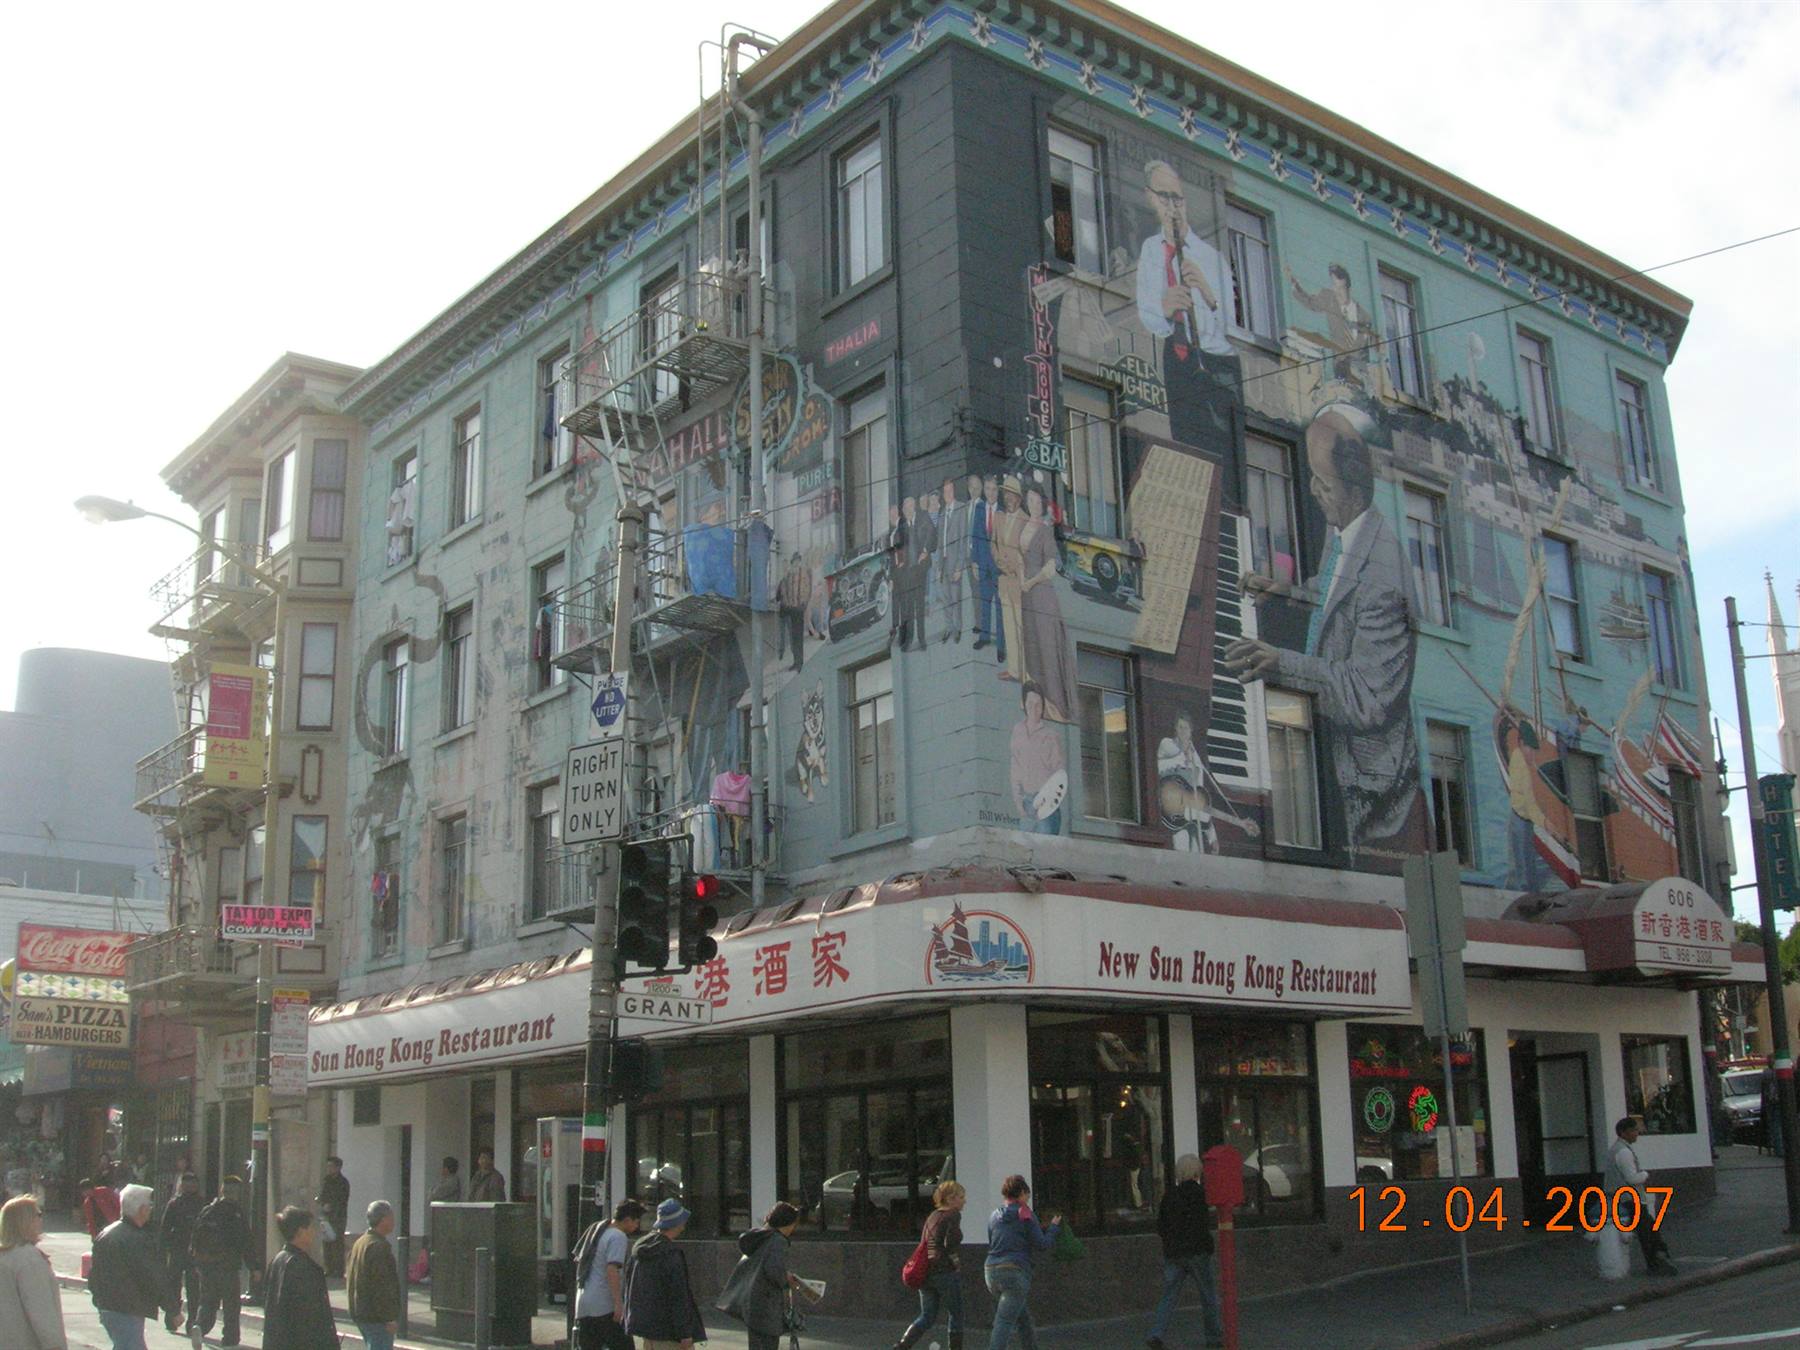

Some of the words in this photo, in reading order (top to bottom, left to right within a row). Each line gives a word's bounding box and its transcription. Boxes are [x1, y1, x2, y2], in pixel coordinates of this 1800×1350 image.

[825, 320, 879, 363] THALIA
[596, 703, 621, 718] LITTER
[572, 750, 619, 777] RIGHT
[571, 779, 618, 804] TURN
[569, 807, 616, 833] ONLY
[1667, 888, 1694, 908] 606
[280, 907, 313, 922] EXPO
[1641, 911, 1725, 942] 新香港酒家
[226, 925, 257, 934] COW
[1098, 941, 1140, 980] New
[1149, 945, 1183, 982] Sun
[1191, 950, 1236, 995] Hong
[1243, 954, 1285, 998] Kong
[1289, 958, 1378, 996] Restaurant
[17, 1000, 53, 1021] Sam's
[54, 1004, 127, 1029] PIZZA
[624, 996, 706, 1020] GRANT
[34, 1024, 123, 1045] HAMBURGERS
[311, 1050, 339, 1075] Sun
[344, 1043, 386, 1072] Hong
[389, 1036, 435, 1066] Kong
[438, 1012, 556, 1058] Restaurant
